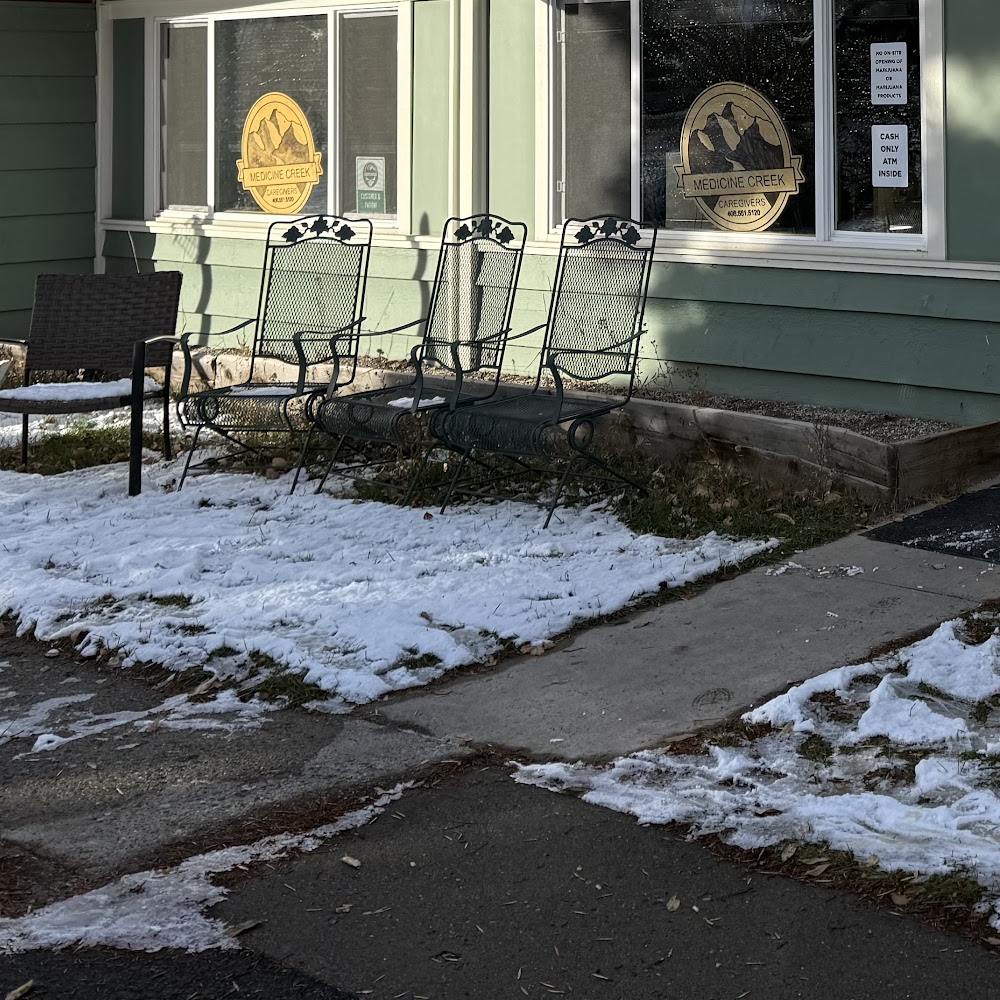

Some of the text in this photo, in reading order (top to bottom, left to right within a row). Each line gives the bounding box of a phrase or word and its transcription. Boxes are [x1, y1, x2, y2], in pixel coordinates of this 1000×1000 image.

[250, 168, 310, 182] MEDICINE CREEK
[693, 174, 786, 191] MEDICINE CREEK
[266, 187, 298, 196] CAREGIVERS
[718, 198, 766, 208] CAREGIVERS
